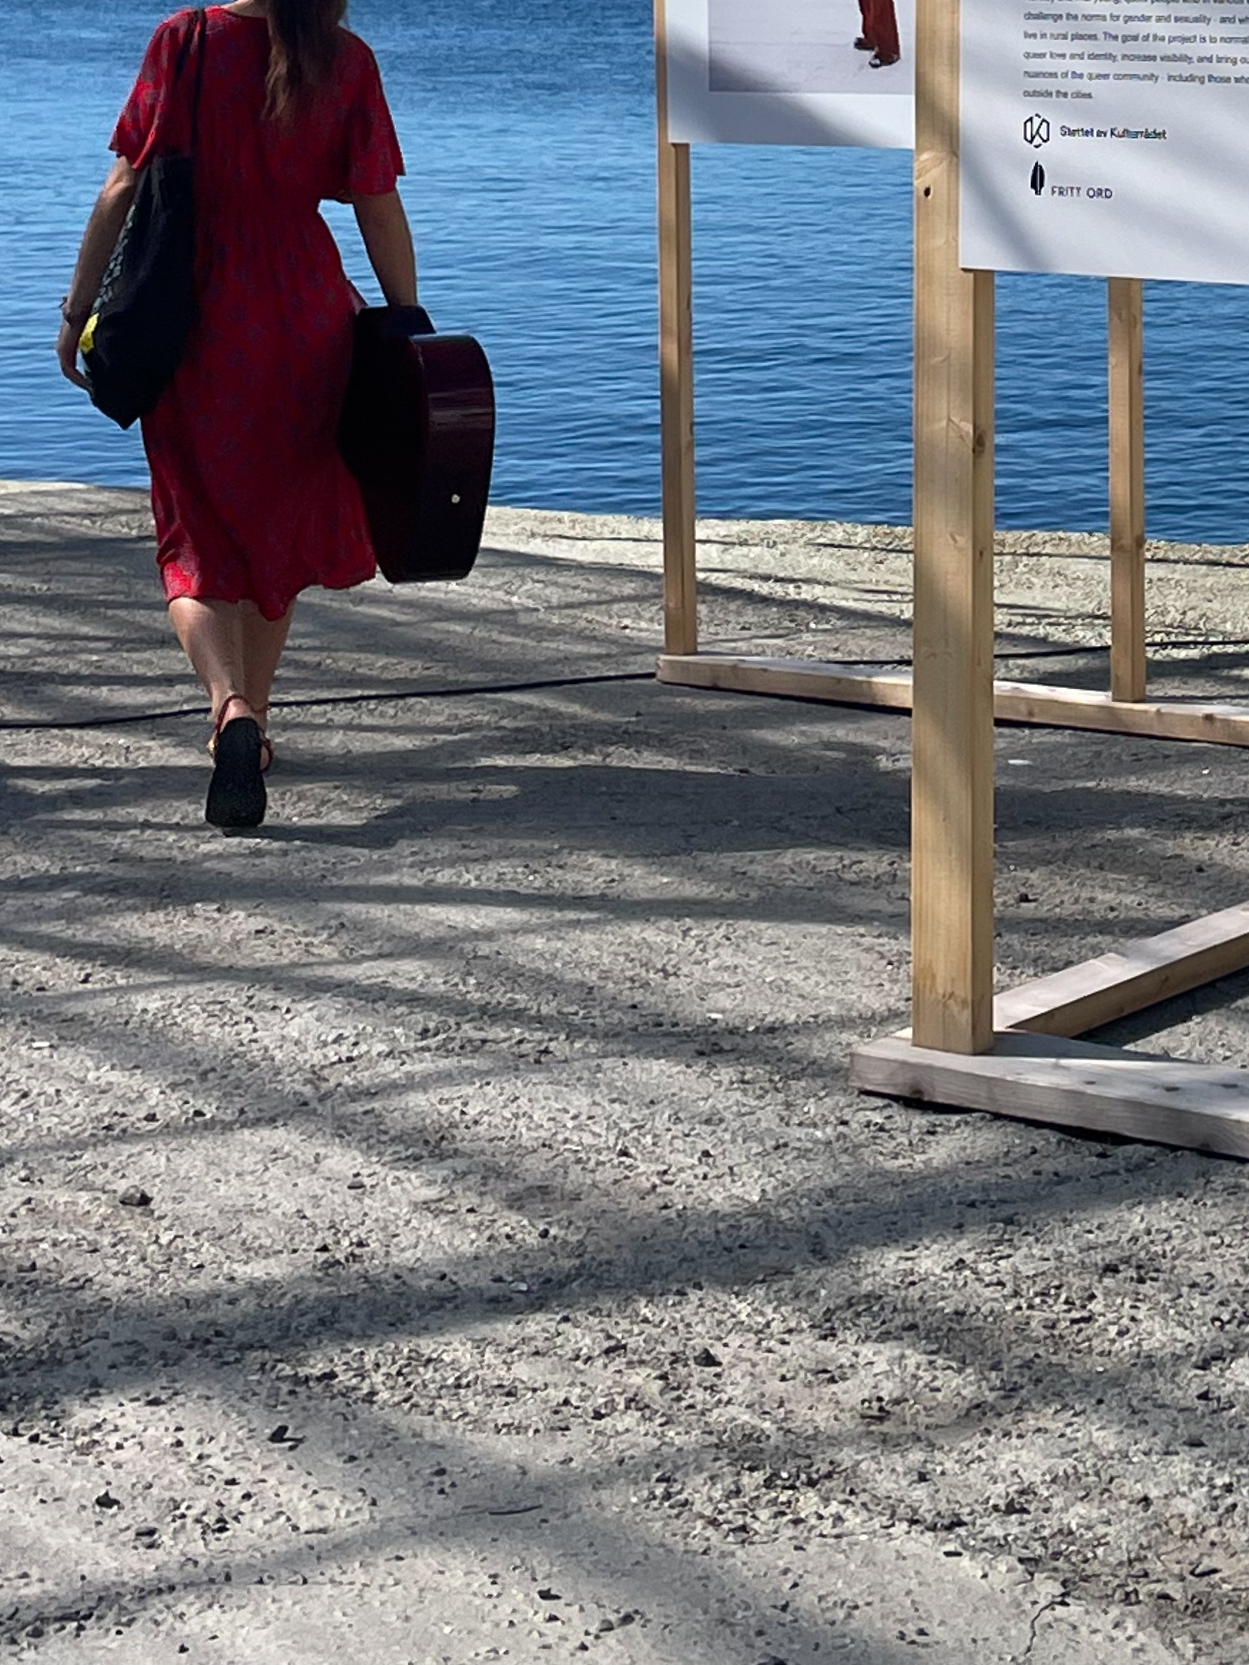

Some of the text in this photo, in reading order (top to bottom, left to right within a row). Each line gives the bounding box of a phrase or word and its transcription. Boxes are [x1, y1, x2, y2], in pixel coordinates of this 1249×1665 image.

[1096, 130, 1107, 138] av
[1051, 186, 1113, 199] FRITT ORD
